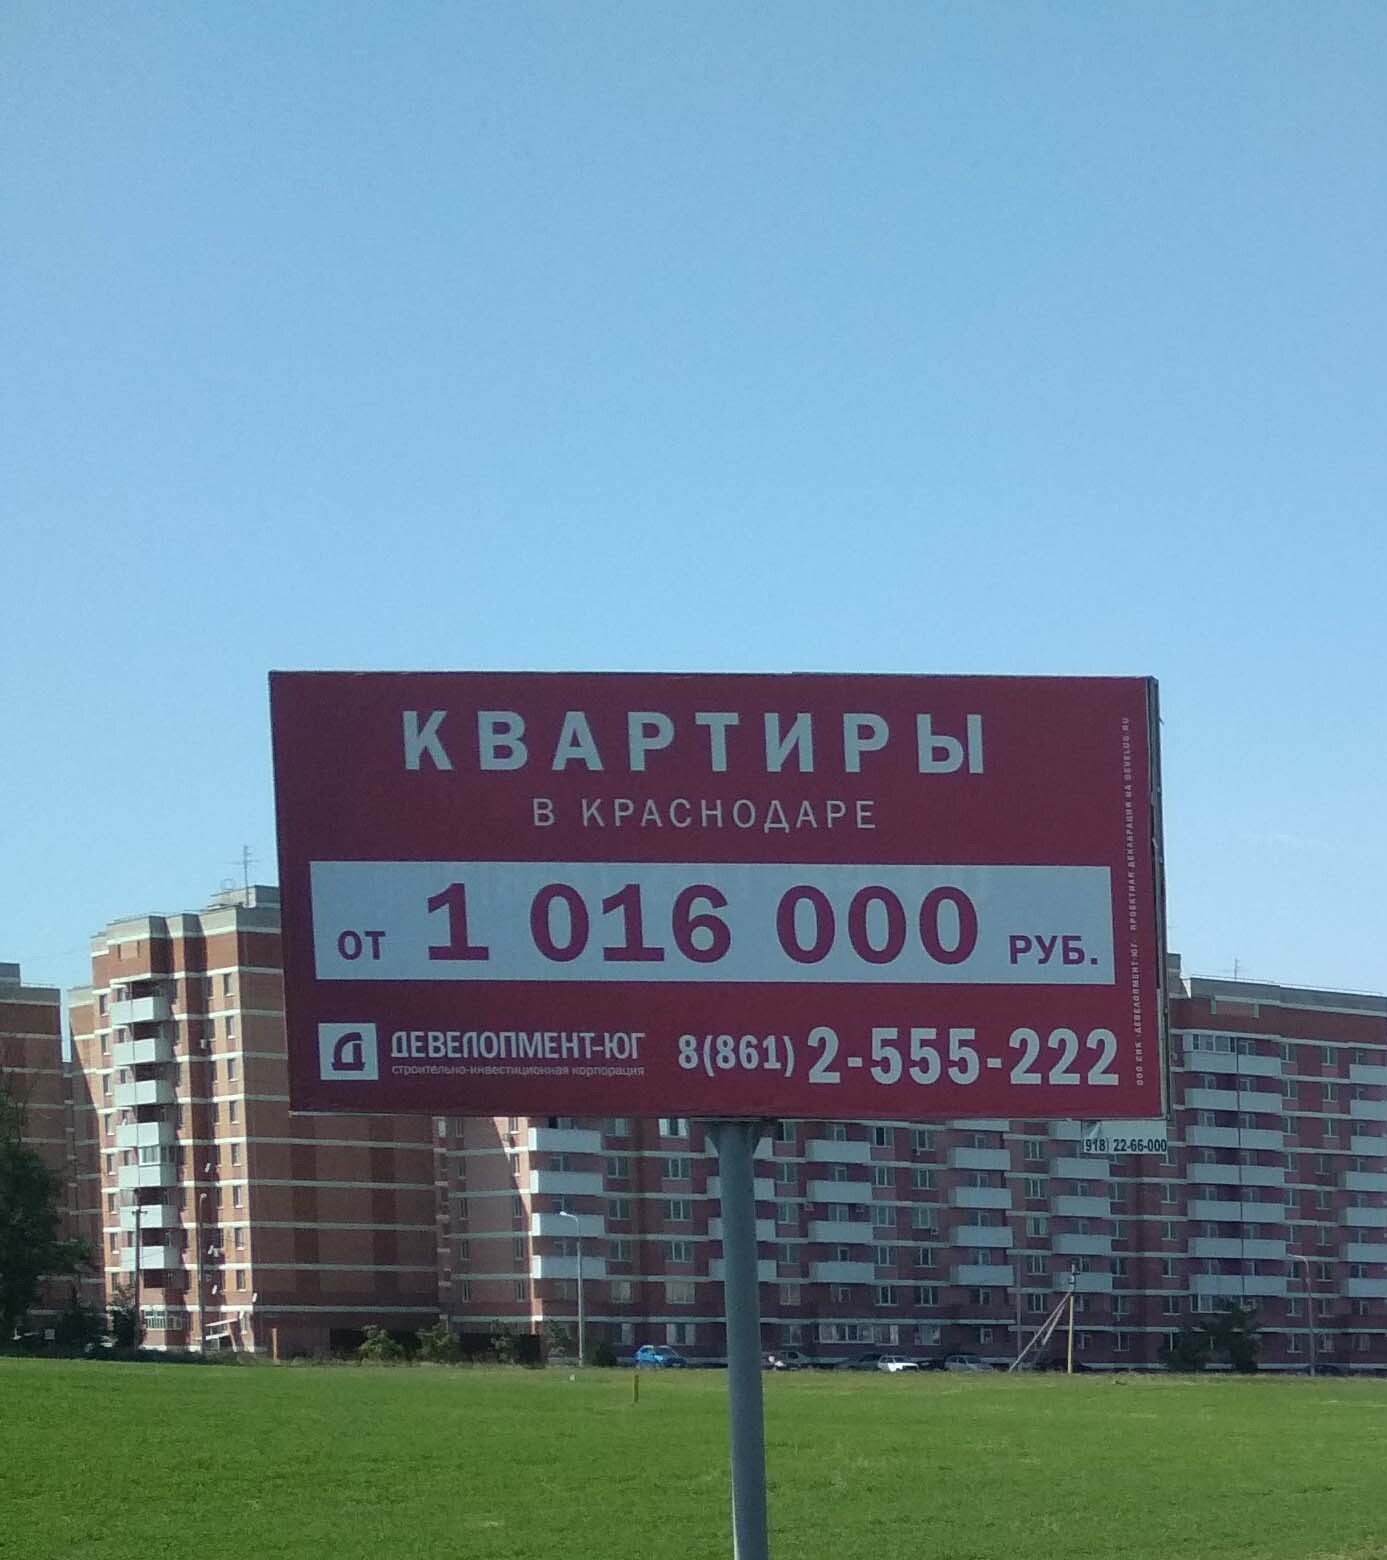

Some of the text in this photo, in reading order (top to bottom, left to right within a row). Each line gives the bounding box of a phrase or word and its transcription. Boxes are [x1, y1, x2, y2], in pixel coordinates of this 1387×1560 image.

[402, 710, 985, 775] КВАРТИРЫ
[532, 799, 878, 833] В КРАСНОДАРЕ
[337, 882, 1099, 966] ОТ 1 016 000 РУБ.
[391, 1031, 646, 1060] ДЕВЕЛОПМЕНТ-ЮГ
[678, 1026, 1119, 1086] 8(861) 2-555-222
[391, 1064, 646, 1078] строительно-инвестиционная корпорация
[1113, 1138, 1168, 1152] 22-66-000
